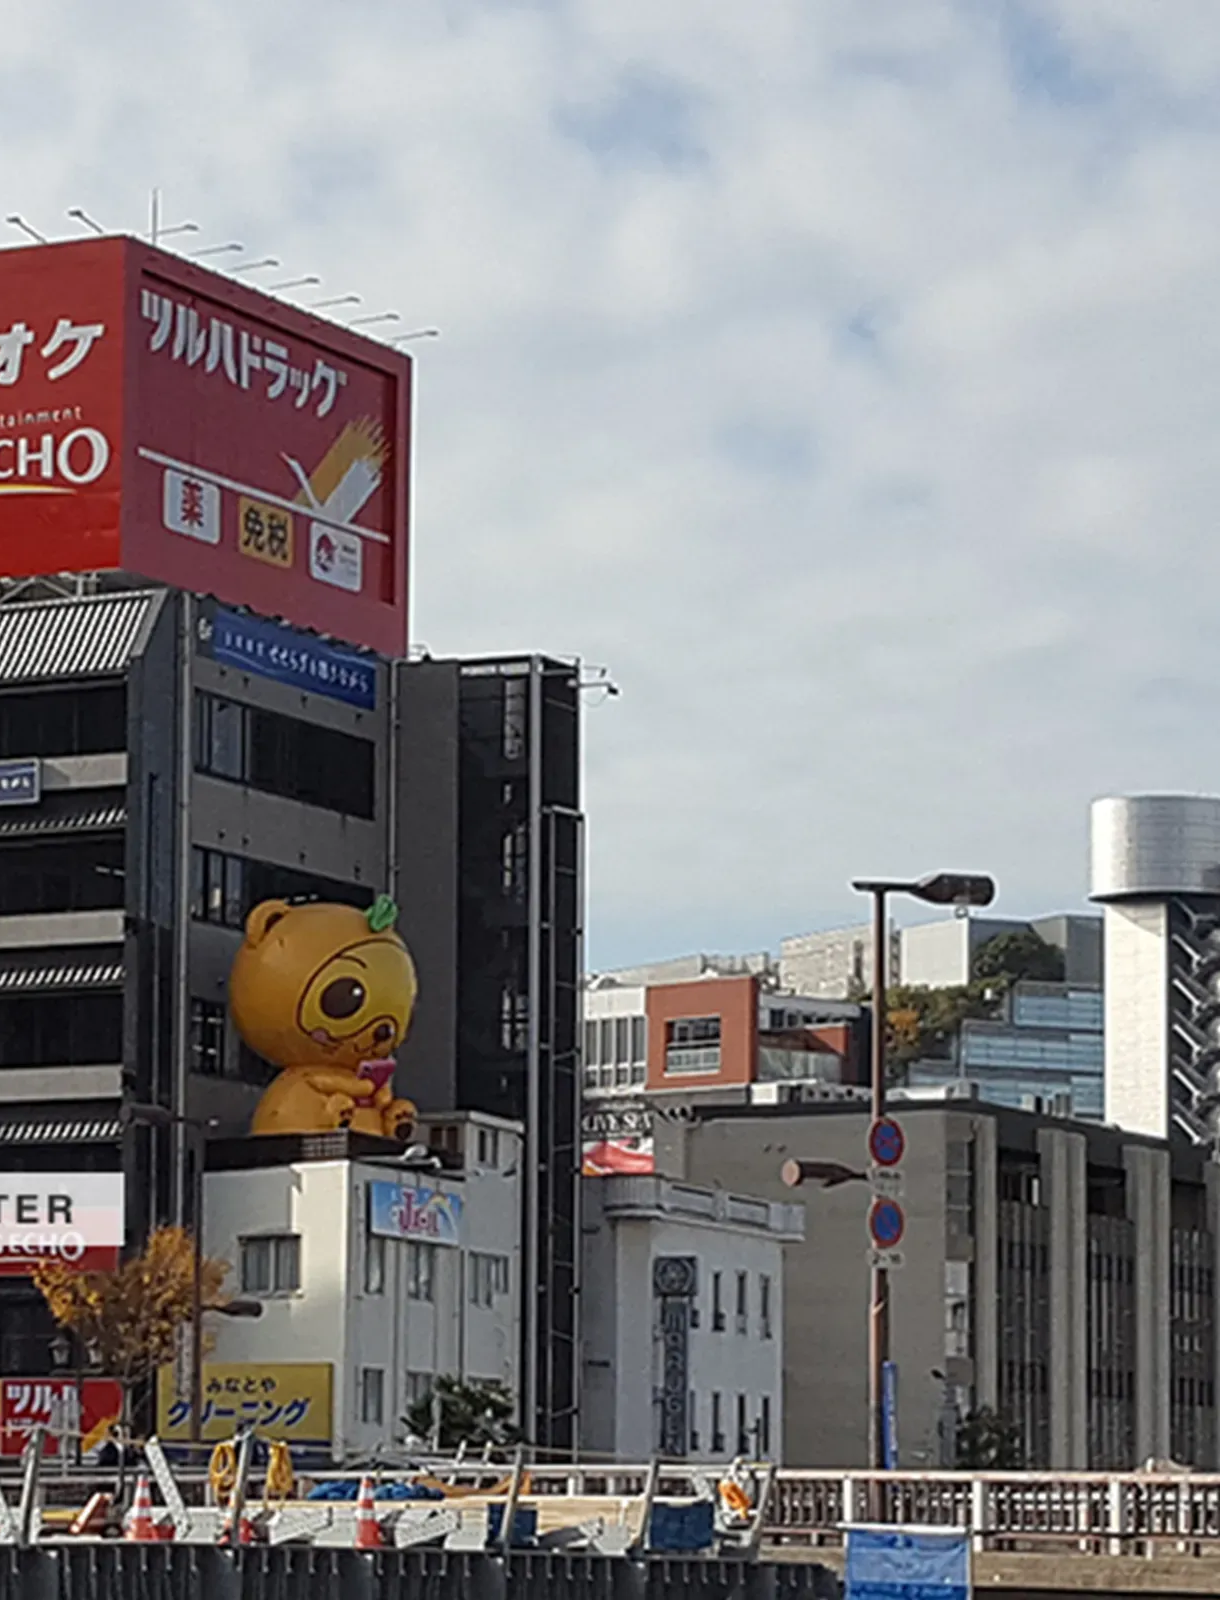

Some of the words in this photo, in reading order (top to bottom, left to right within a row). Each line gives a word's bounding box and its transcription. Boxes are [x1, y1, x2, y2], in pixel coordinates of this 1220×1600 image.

[141, 289, 347, 417] ツルハドラッグ
[242, 506, 289, 562] 免税
[11, 1231, 85, 1262] ECHO
[207, 1376, 277, 1394] みなとや
